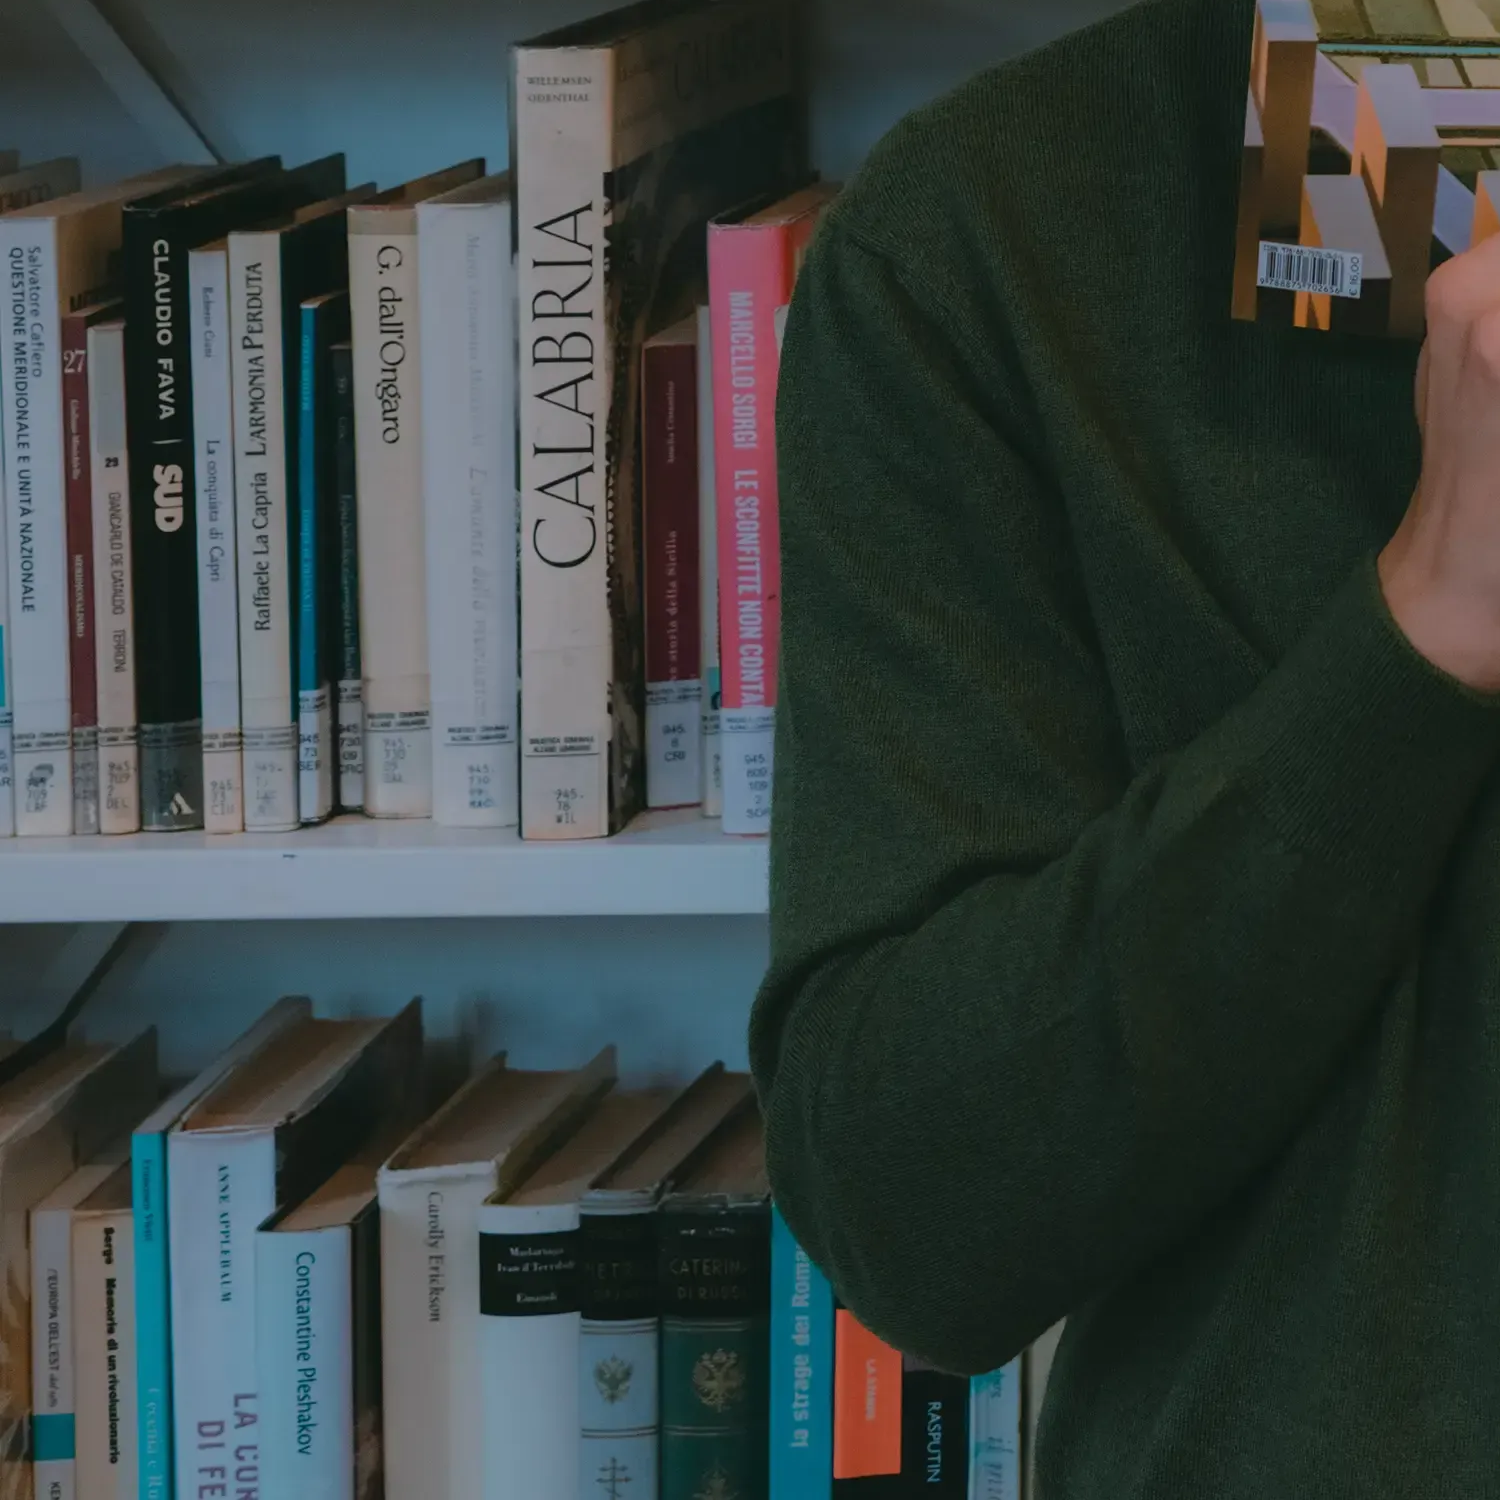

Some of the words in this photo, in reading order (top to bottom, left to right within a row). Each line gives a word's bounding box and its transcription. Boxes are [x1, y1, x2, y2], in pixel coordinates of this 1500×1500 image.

[8, 246, 27, 337] QUESTIONE
[152, 239, 173, 346] CLAUDIO
[376, 244, 402, 276] G.
[241, 262, 265, 351] PERDUTA
[13, 341, 30, 450] MERIDIONALE
[156, 358, 175, 420] FAVA
[376, 286, 406, 444] dall'Ongaro
[531, 199, 597, 571] CALABRIA
[17, 455, 31, 463] E
[19, 468, 36, 517] UNITÀ
[152, 463, 184, 533] SUD
[250, 472, 273, 529] Capria
[19, 522, 36, 613] NAZIONALE
[253, 534, 270, 556] La
[253, 561, 272, 631] Raffaele
[426, 1190, 445, 1254] Carolly
[294, 1250, 318, 1361] Constantine
[426, 1256, 441, 1324] Erickson
[295, 1363, 315, 1457] Pleshakov
[925, 1400, 947, 1485] RASPUTIN
